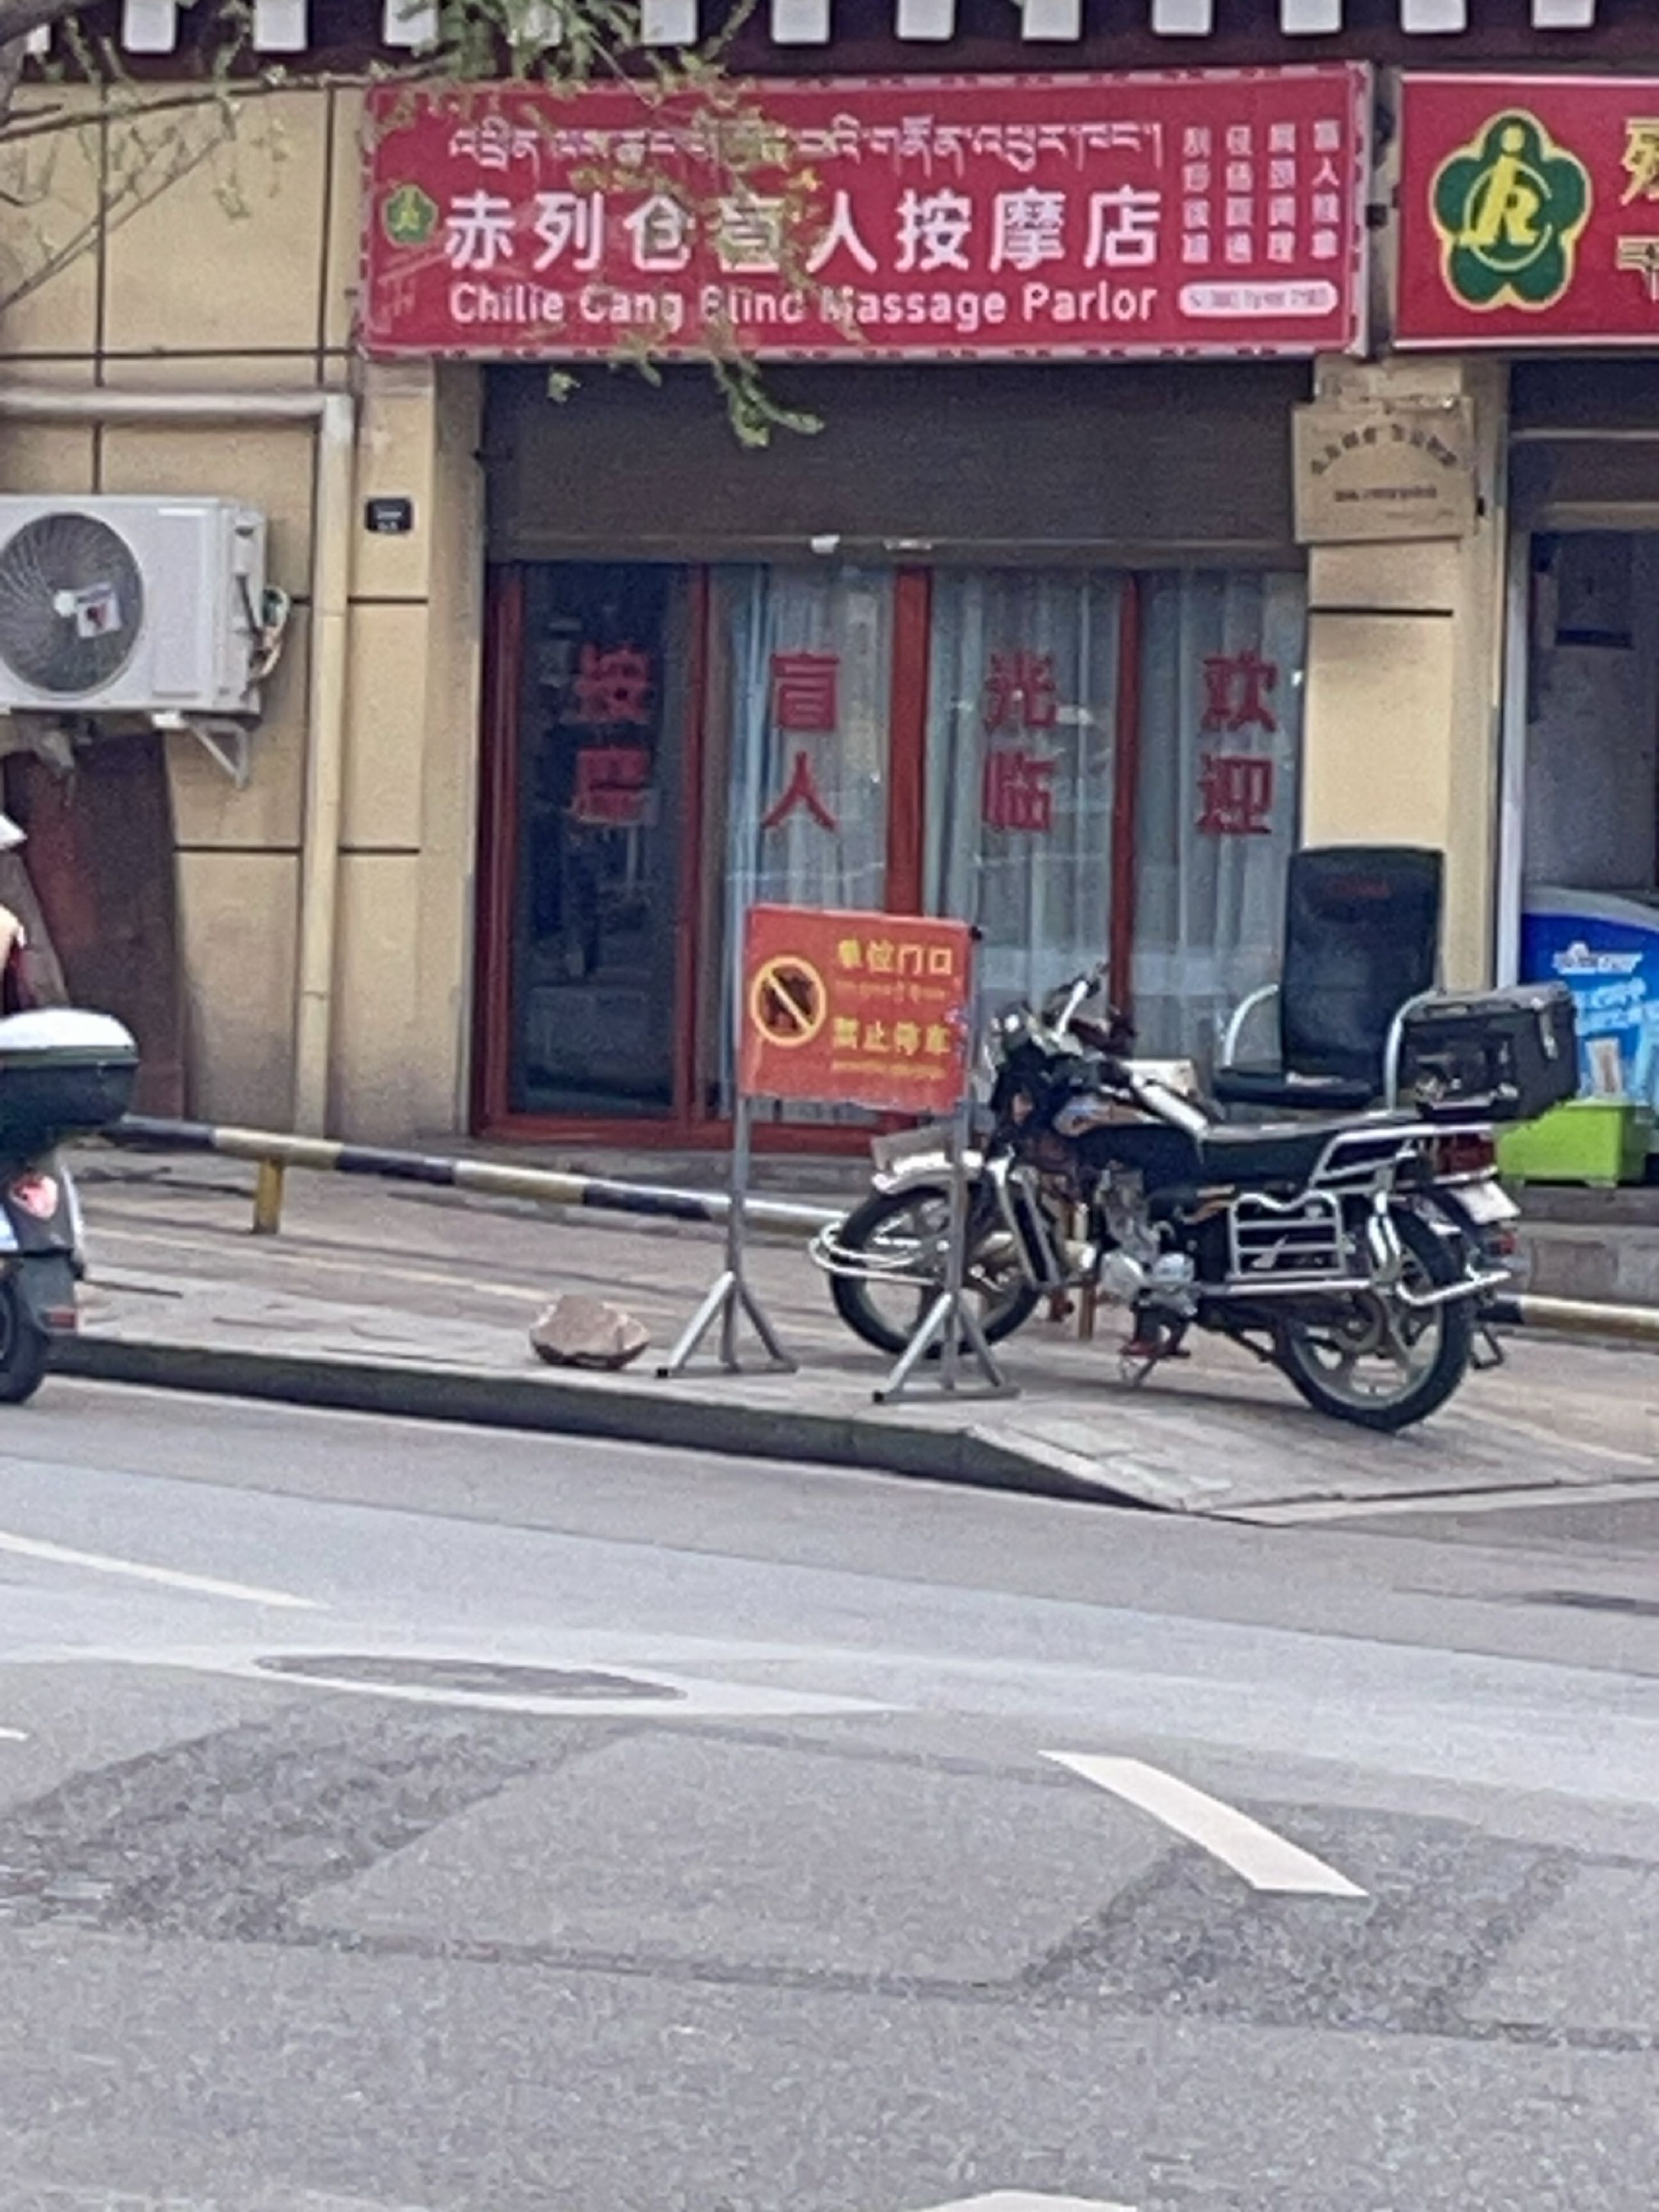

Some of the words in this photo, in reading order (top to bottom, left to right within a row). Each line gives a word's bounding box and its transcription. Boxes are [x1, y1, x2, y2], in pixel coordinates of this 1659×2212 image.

[445, 184, 1162, 275] 赤列仓盲人按摩店
[450, 282, 565, 324] Chilie
[1024, 280, 1157, 322] Parlor
[762, 649, 840, 831] 盲人
[981, 649, 1056, 831] 光临
[1196, 649, 1279, 835] 欢迎
